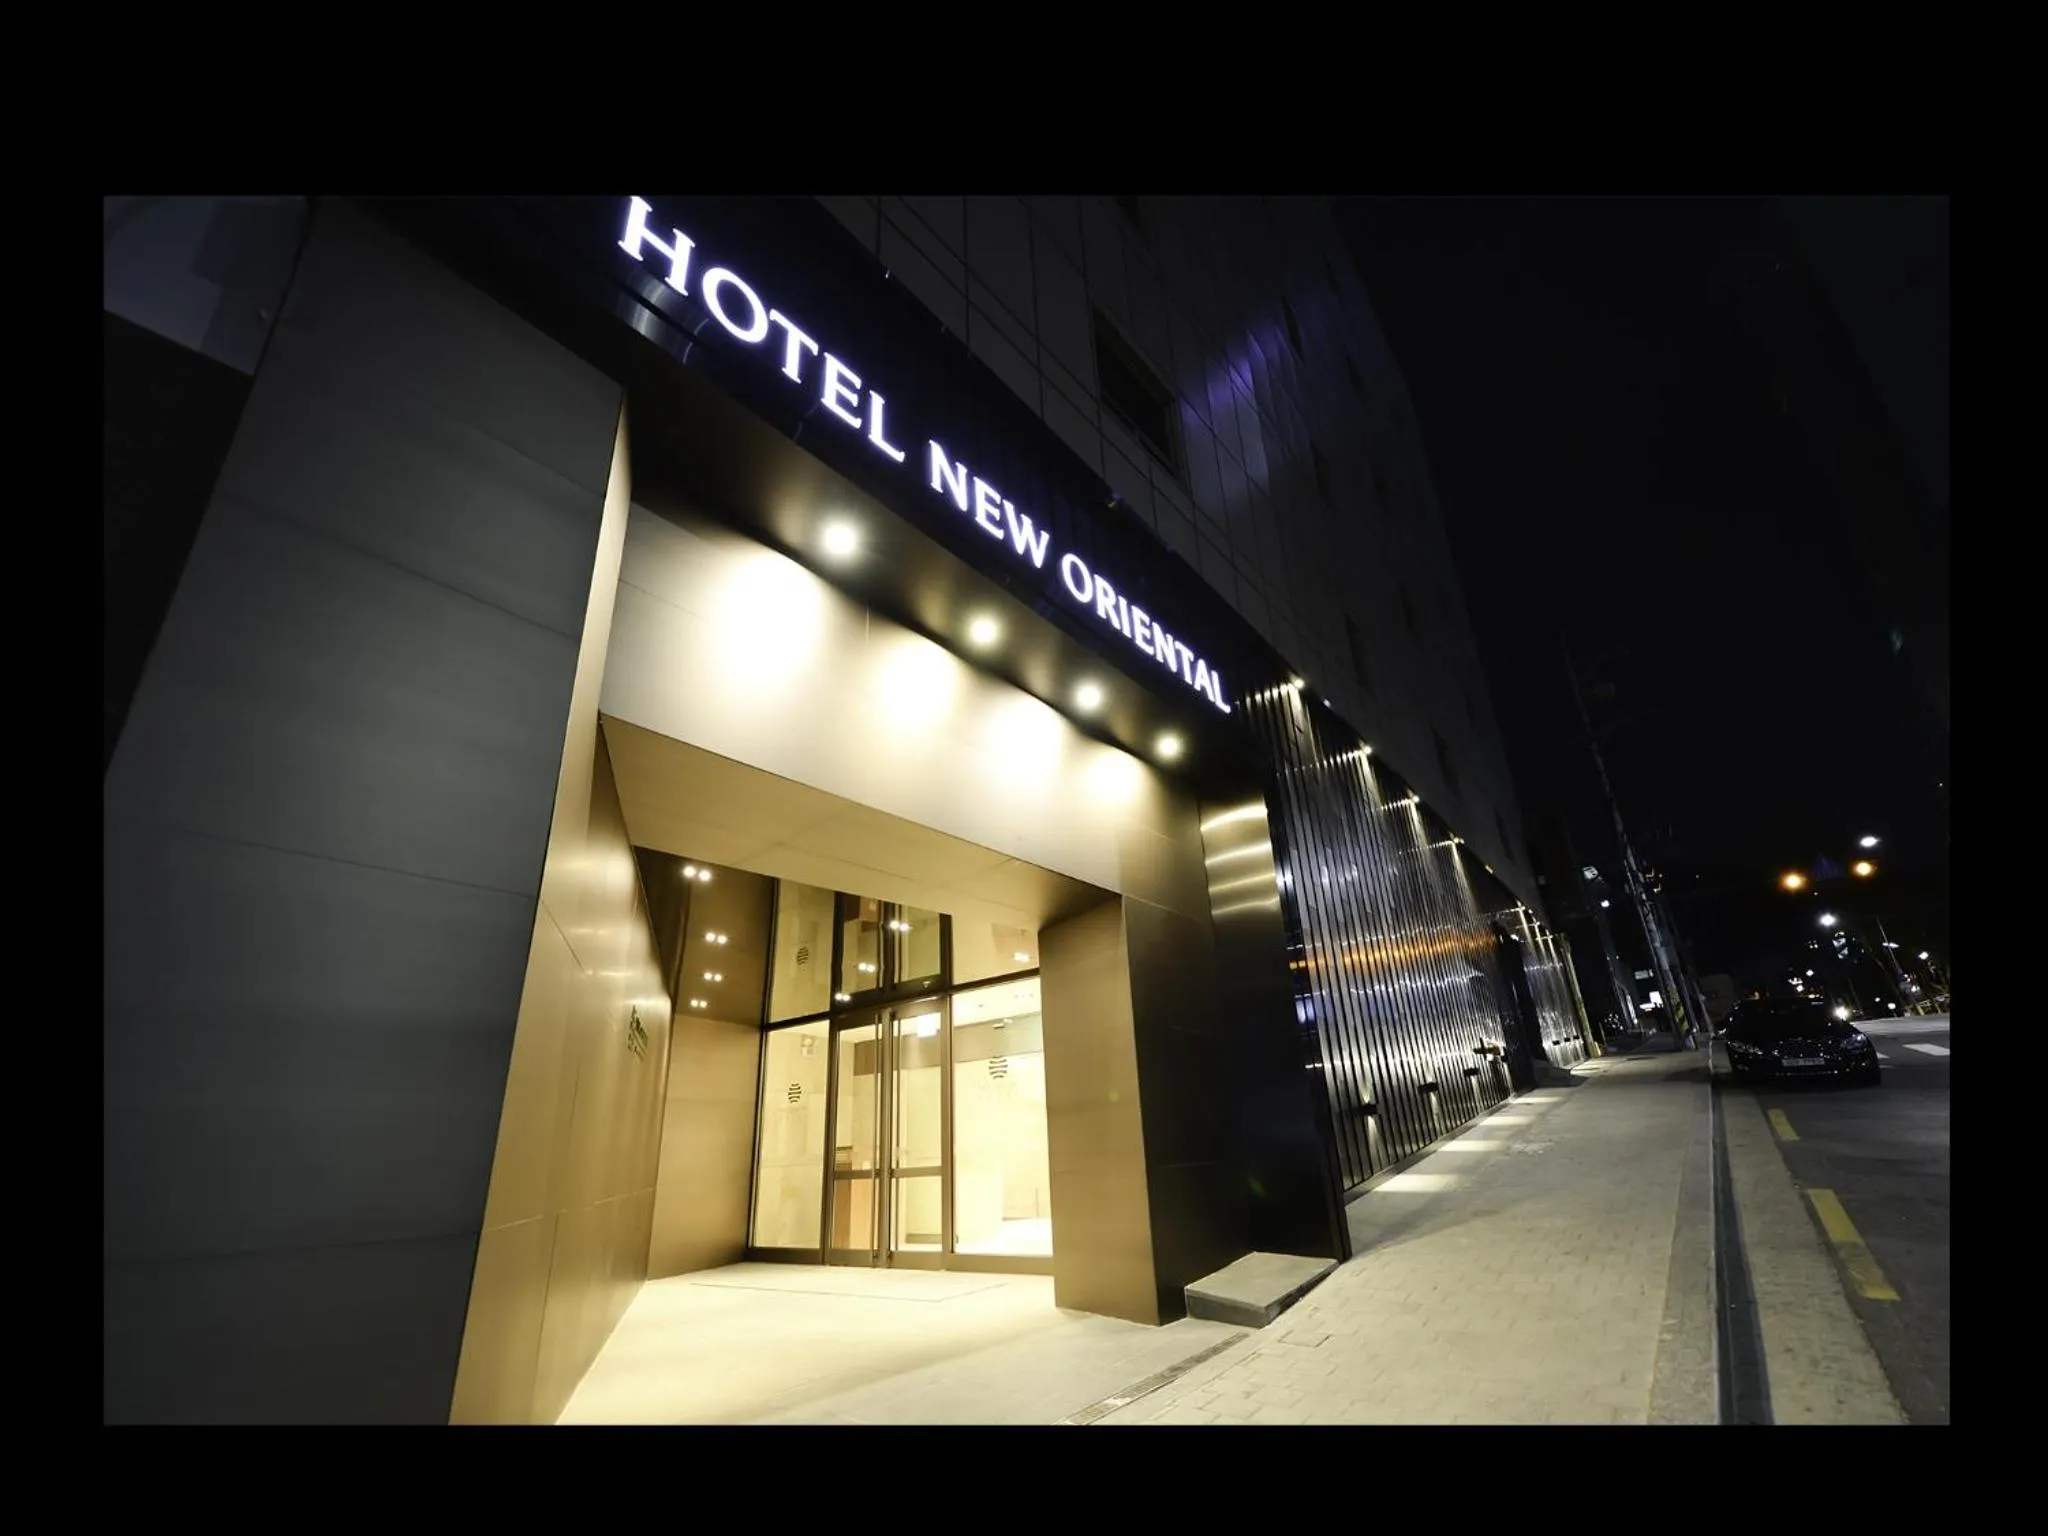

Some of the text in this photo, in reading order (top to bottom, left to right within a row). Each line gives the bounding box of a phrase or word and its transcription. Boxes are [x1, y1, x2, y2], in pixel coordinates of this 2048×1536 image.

[617, 196, 1231, 714] HOTEL NEW ORIENTAL
